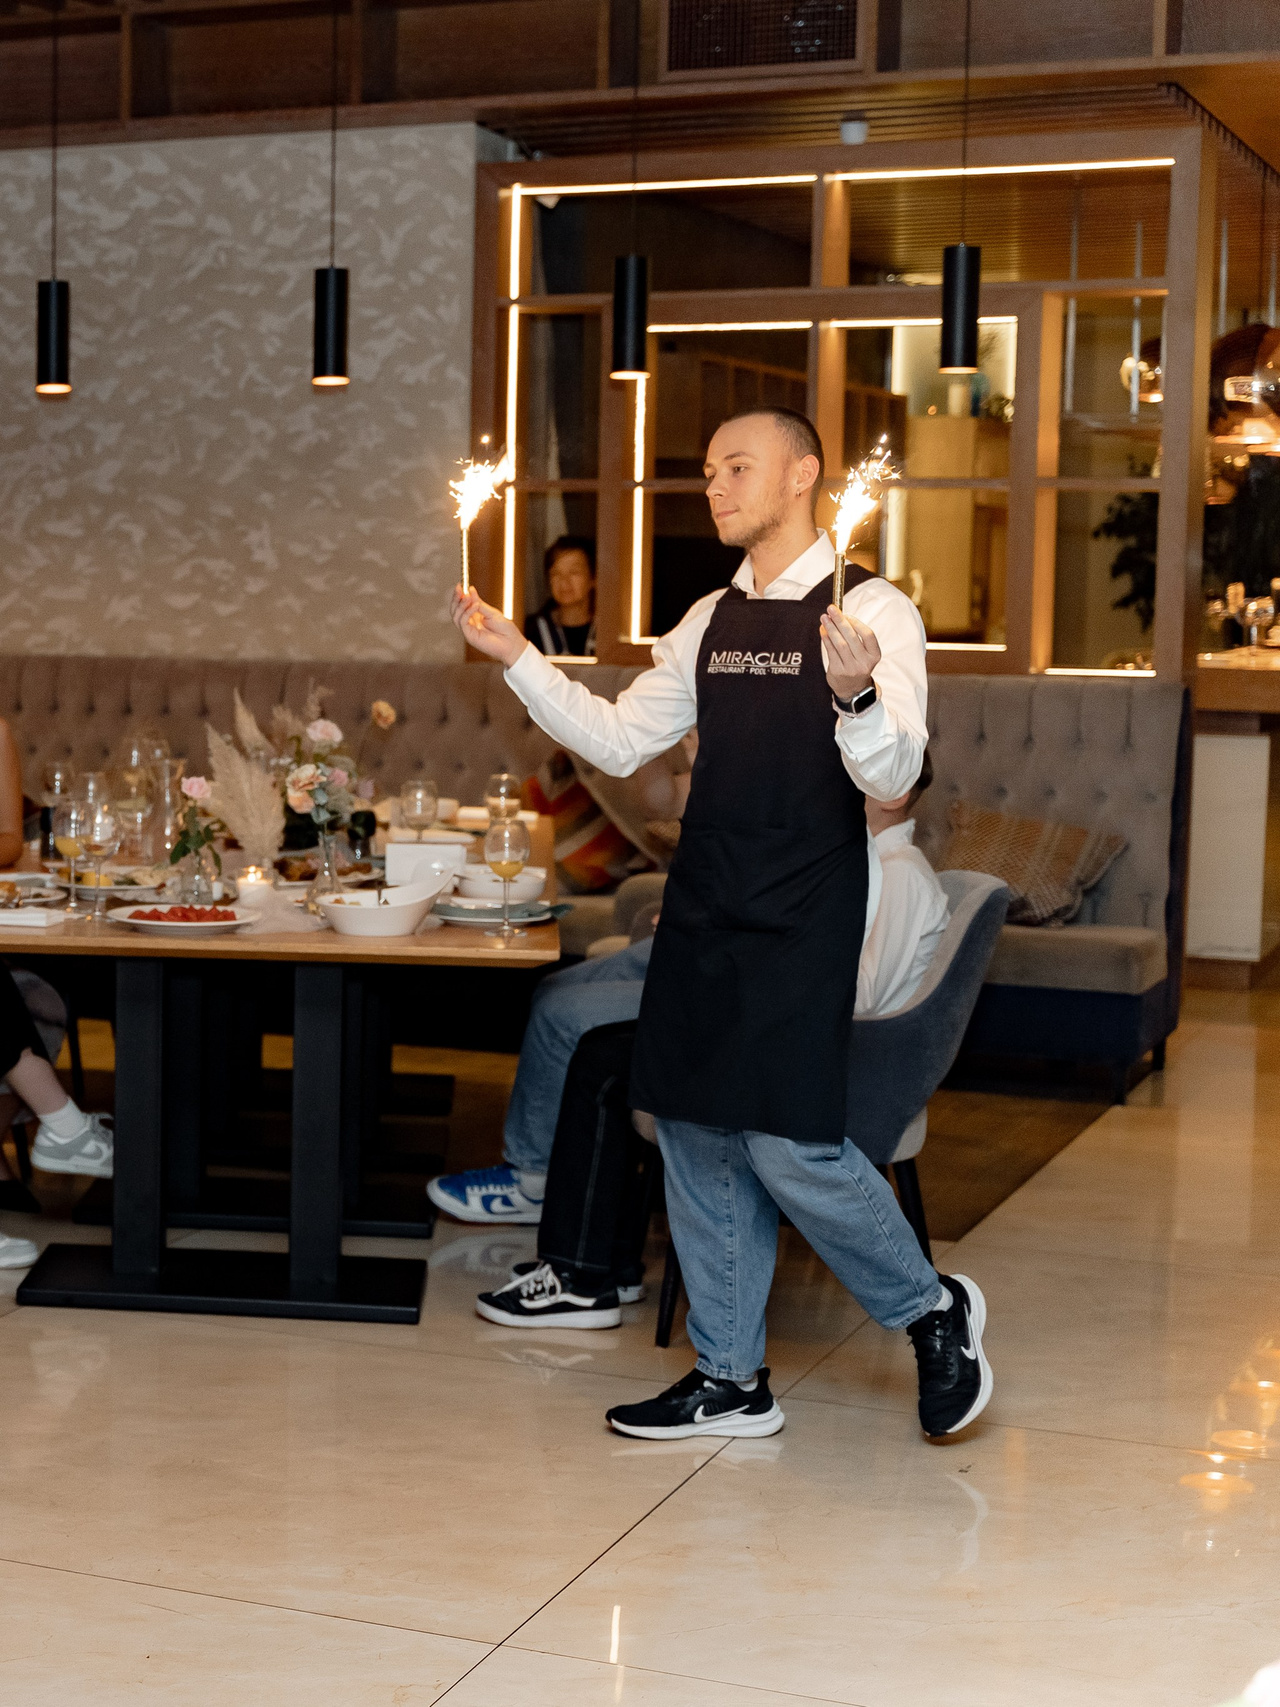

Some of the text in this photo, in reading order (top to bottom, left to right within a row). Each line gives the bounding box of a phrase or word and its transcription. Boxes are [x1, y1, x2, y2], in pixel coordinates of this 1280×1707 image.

[710, 651, 802, 666] MIRACLUB
[707, 666, 800, 675] RESTAURANT POOL TERRACE
